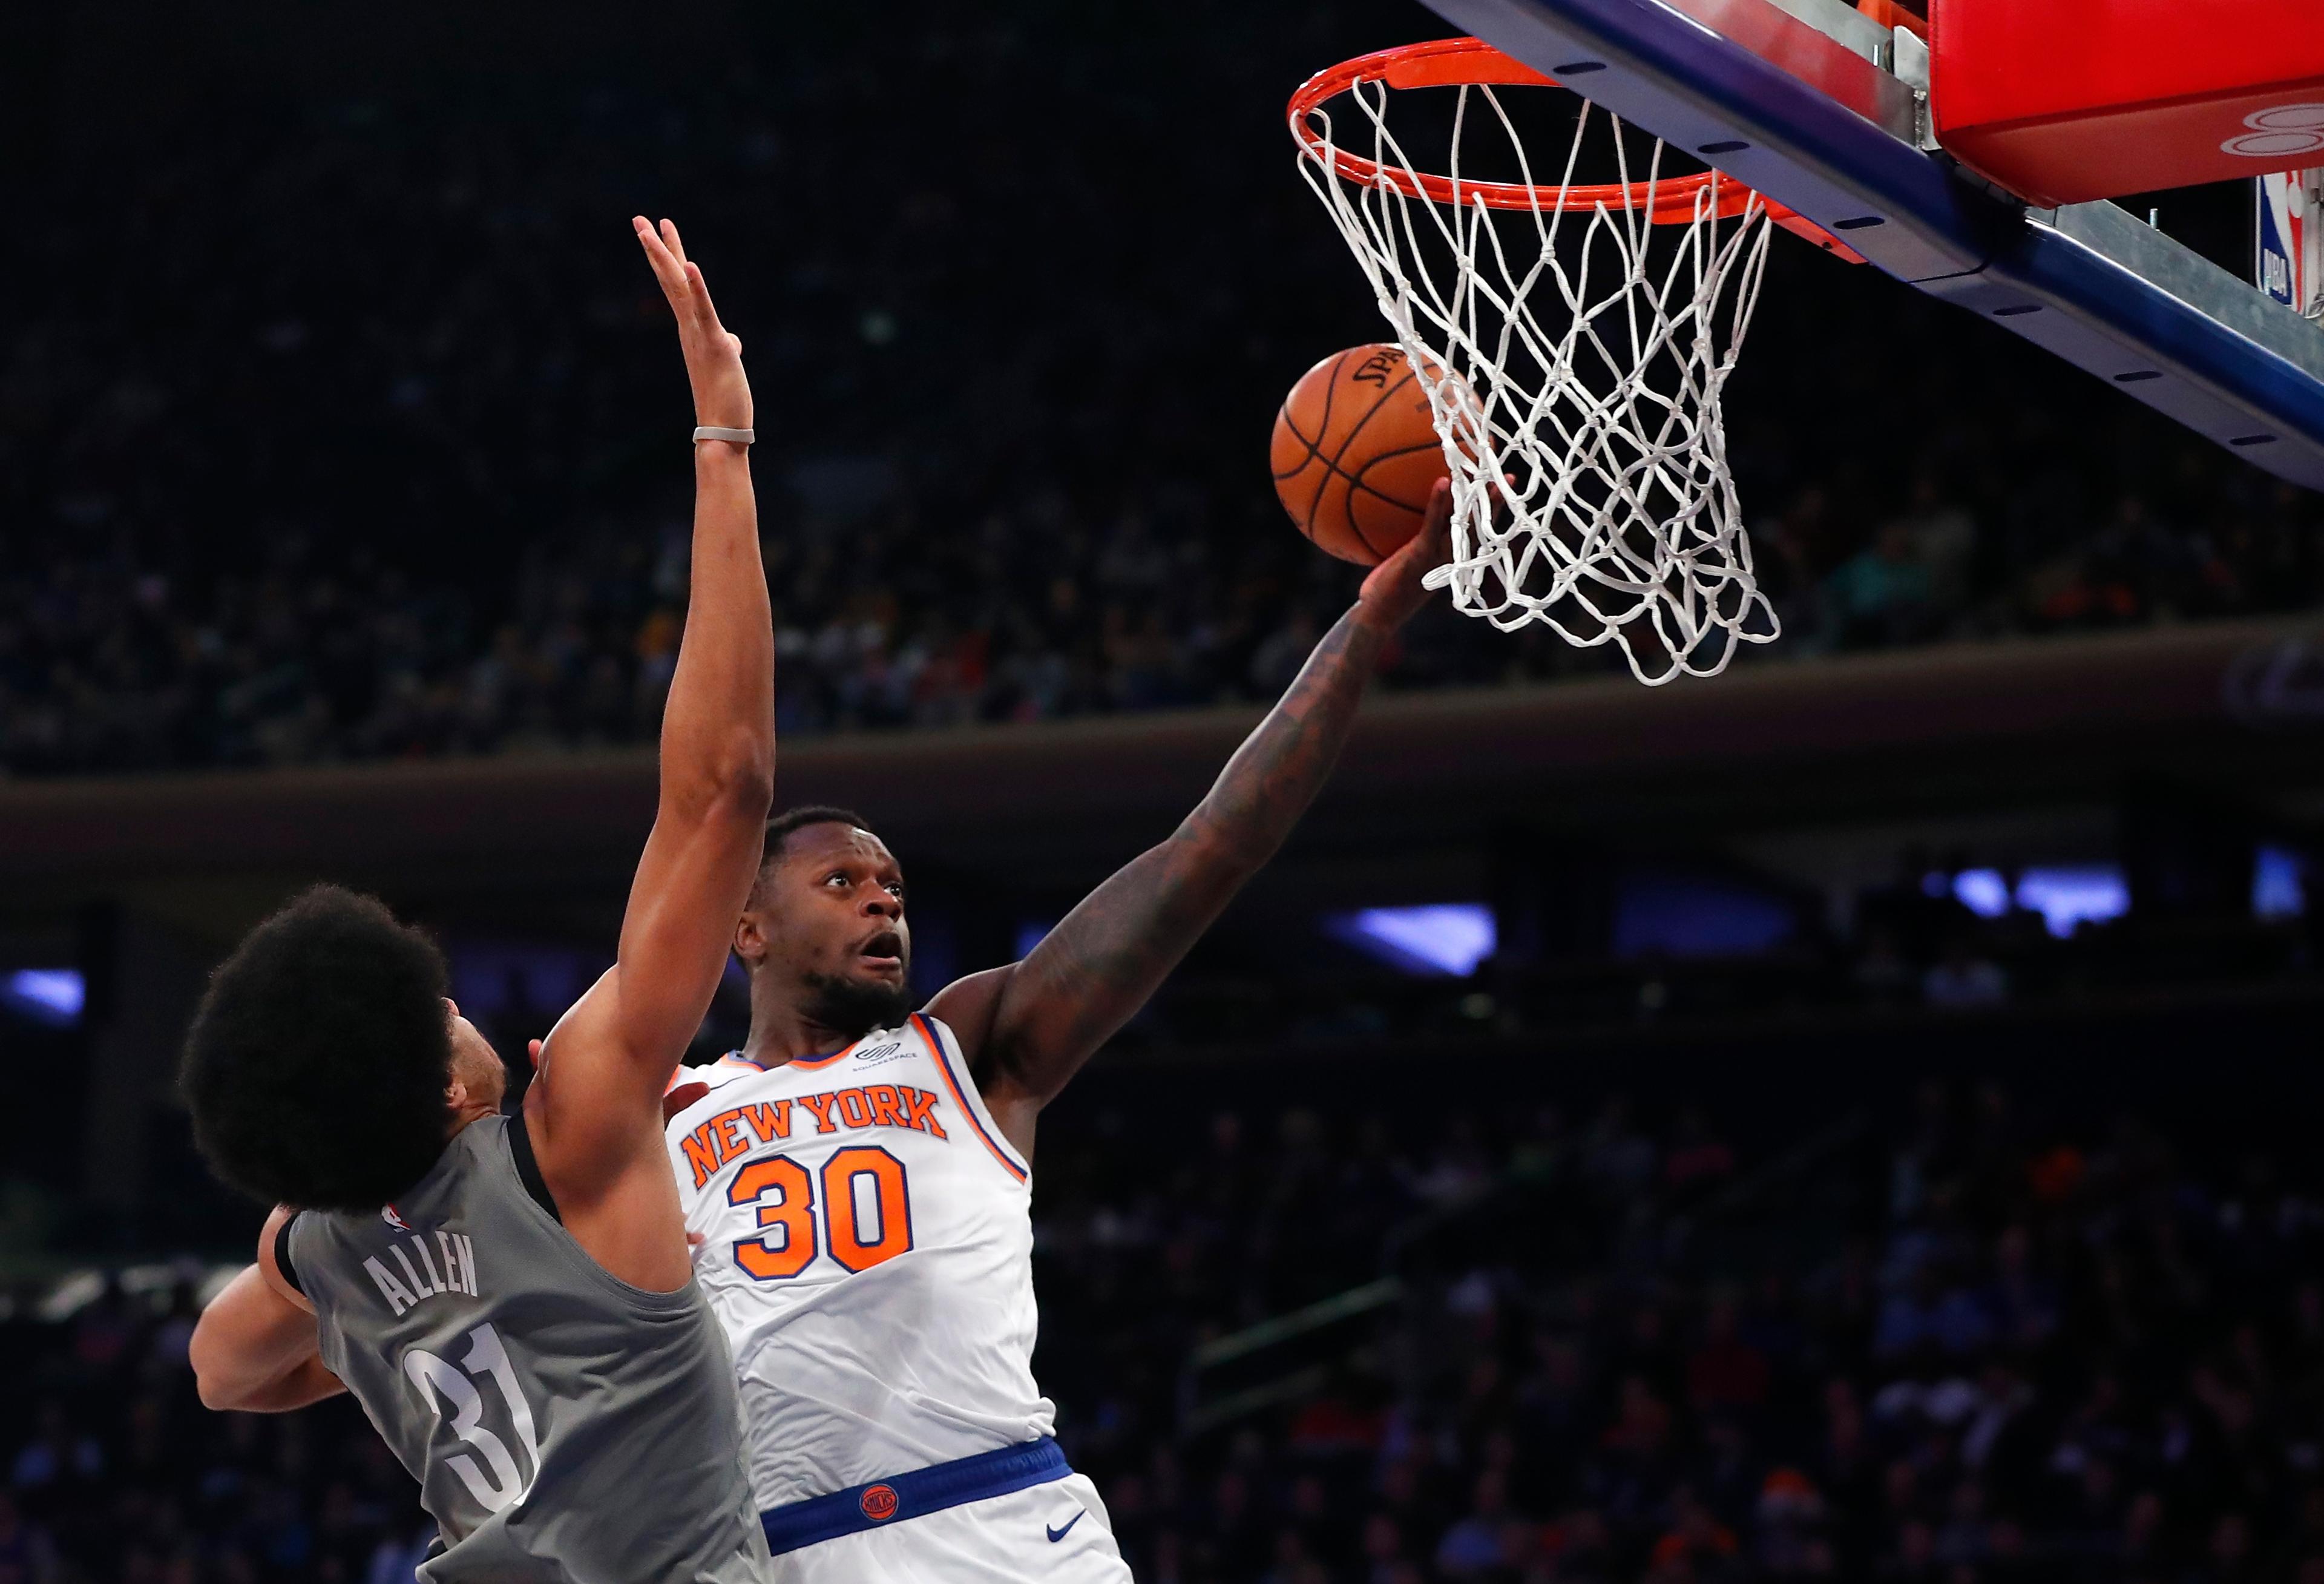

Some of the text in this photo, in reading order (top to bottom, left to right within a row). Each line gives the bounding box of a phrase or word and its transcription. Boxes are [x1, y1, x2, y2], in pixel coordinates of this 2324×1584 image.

[2264, 248, 2287, 297] NBA
[852, 1053, 917, 1072] SQUARESPACE
[680, 1084, 950, 1194] NEW YORK
[726, 1145, 914, 1281] 30
[363, 1231, 478, 1316] ALLEN
[404, 1323, 540, 1513] 31
[865, 1493, 893, 1511] KNICKS
